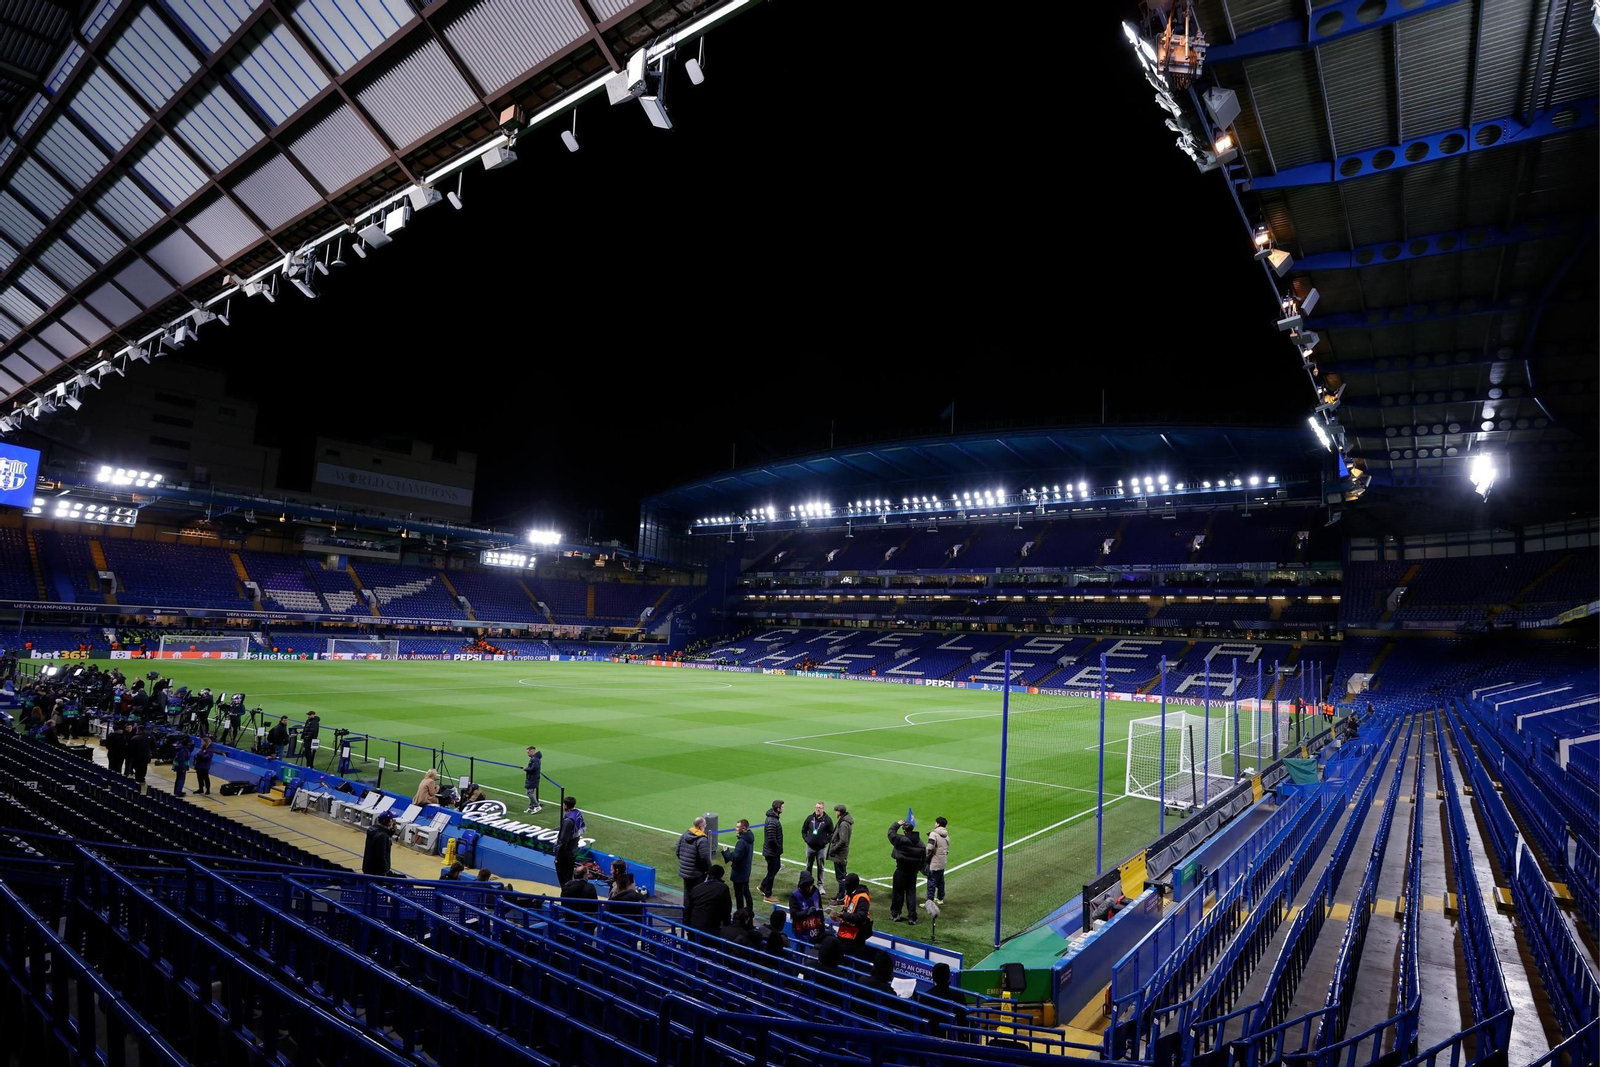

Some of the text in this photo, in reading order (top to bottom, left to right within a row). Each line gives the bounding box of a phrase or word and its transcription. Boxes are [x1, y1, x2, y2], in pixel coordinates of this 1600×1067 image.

[335, 470, 458, 501] WORLD CHAMPIONS
[754, 629, 1263, 664] CHELSEA
[31, 650, 89, 660] bet365
[243, 652, 297, 660] Heineken
[723, 665, 752, 673] crypto.com
[762, 667, 786, 676] bet365
[796, 670, 828, 679] Heineken
[925, 679, 955, 688] PEPSI
[1040, 688, 1089, 697] mastercard
[1131, 693, 1159, 703] FedEx
[1166, 697, 1196, 706] QATAR
[462, 811, 596, 848] CHAMPIOS
[907, 964, 915, 972] AN
[915, 967, 933, 977] OFFEN
